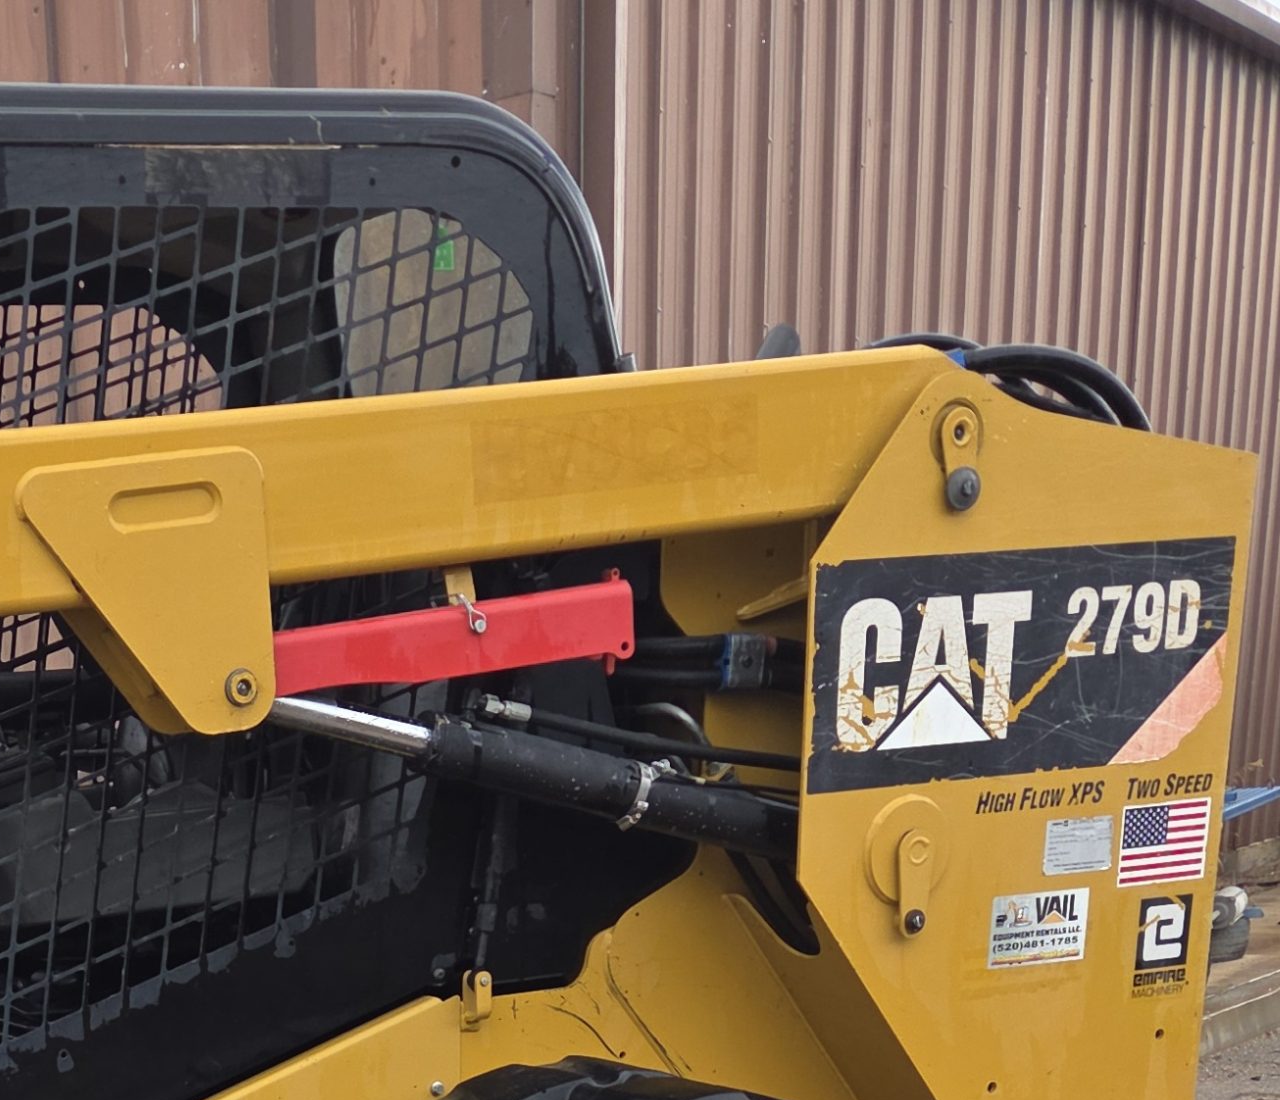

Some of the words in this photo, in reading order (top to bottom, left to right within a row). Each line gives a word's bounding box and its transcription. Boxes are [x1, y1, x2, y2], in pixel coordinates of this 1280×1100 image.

[836, 589, 1034, 752] CAT
[1064, 578, 1202, 658] 279D
[976, 790, 1017, 815] HIGH
[1019, 787, 1066, 811] FLOW
[1068, 780, 1106, 806] XPS
[1127, 776, 1161, 800] TWO
[1163, 772, 1214, 797] SPEED
[1035, 893, 1079, 925] VAIL
[993, 930, 1035, 942] EQUIPMENT
[1036, 927, 1067, 937] RENTALS
[1131, 983, 1185, 999] MACHINERY
